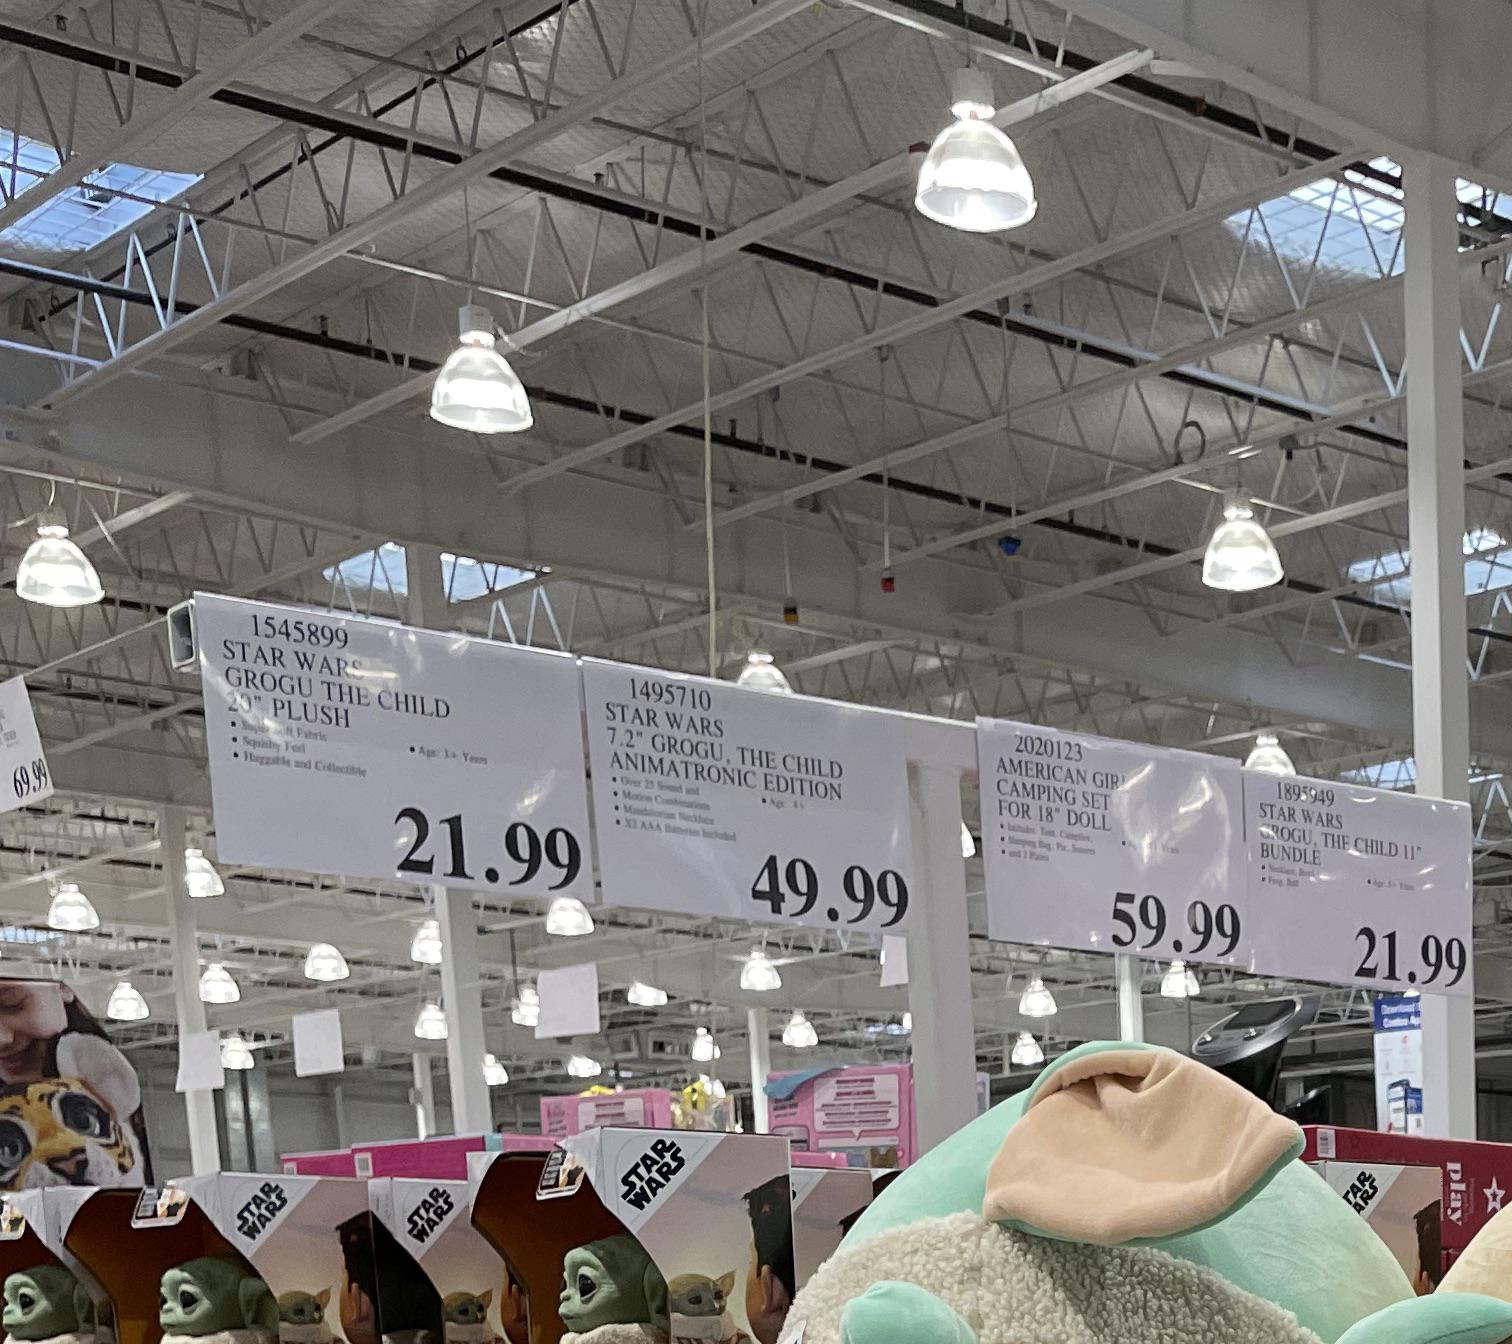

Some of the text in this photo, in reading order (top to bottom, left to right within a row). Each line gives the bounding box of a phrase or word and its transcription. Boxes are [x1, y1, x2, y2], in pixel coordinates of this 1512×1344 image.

[250, 614, 349, 649] 1545899
[223, 640, 363, 680] STAR WARS
[225, 666, 450, 719] GROGU THE CHILD
[629, 678, 712, 711] 1495710
[273, 699, 351, 728] PLUSH
[605, 702, 724, 738] STAR WARS
[607, 727, 844, 780] 7.2" GROGU, THE CHILD
[1015, 734, 1083, 762] 2020123
[13, 758, 48, 799] 69.99
[610, 752, 843, 801] ANIMATRONIC EDITION
[996, 757, 1087, 786] AMERICAN
[996, 779, 1111, 811] CAMPING SET
[998, 799, 1032, 820] FOR
[1038, 804, 1061, 823] 18"
[1067, 810, 1112, 832] DOLL
[1259, 802, 1344, 830] STAR WARS
[395, 806, 582, 891] 21.99
[1260, 842, 1322, 866] BUNDLE
[1322, 832, 1350, 850] THE
[1354, 837, 1399, 858] CHILD
[751, 854, 909, 928] 49.99
[1111, 892, 1241, 957] 59.99
[1354, 926, 1467, 988] 21.99
[621, 1137, 679, 1200] STAR
[622, 1145, 686, 1212] WARS
[1343, 1171, 1373, 1200] TAR
[237, 1181, 281, 1233] STAR
[407, 1186, 450, 1233] STAR
[1350, 1175, 1379, 1214] ARS
[238, 1190, 288, 1241] WARS
[408, 1195, 454, 1244] WARS
